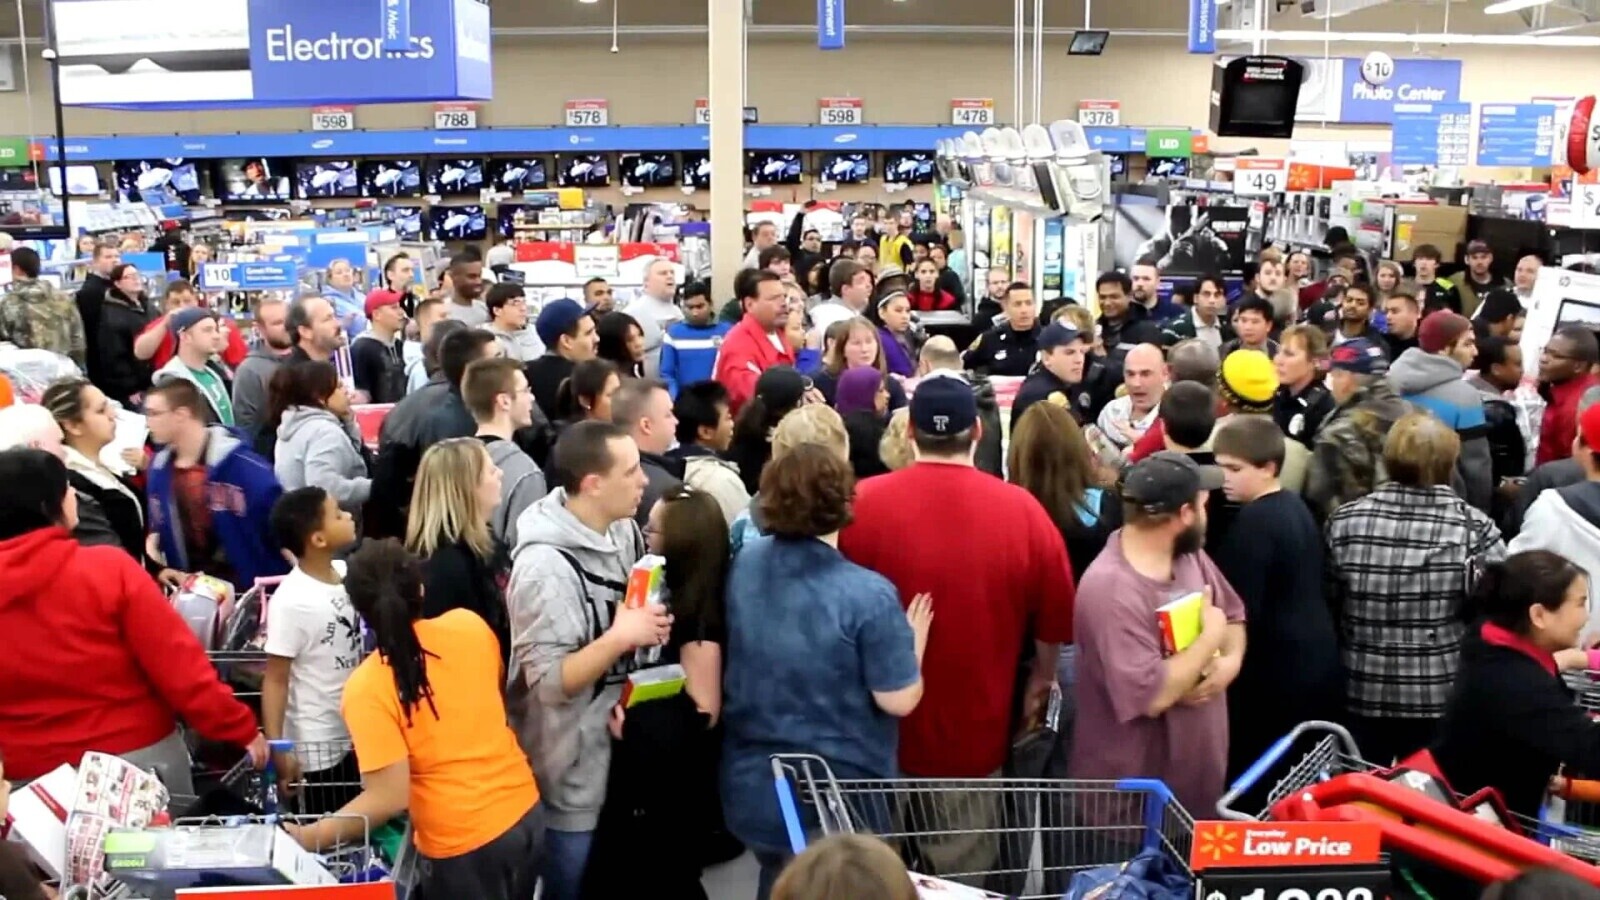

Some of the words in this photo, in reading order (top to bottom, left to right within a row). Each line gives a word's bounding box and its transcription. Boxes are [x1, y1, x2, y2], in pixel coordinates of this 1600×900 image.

[387, 9, 399, 40] Music
[266, 24, 434, 61] Electroncs
[1366, 62, 1391, 77] $10
[1397, 83, 1447, 101] Center
[317, 115, 348, 128] $598
[438, 113, 469, 127] $788
[570, 110, 601, 124] $578
[824, 109, 854, 123] $598
[957, 110, 988, 123] $478
[1084, 111, 1114, 125] $378
[1159, 137, 1179, 149] LED
[1246, 173, 1277, 192] $49
[206, 268, 230, 281] $10
[933, 415, 949, 431] T
[1243, 838, 1292, 856] Low
[1295, 837, 1352, 856] Price
